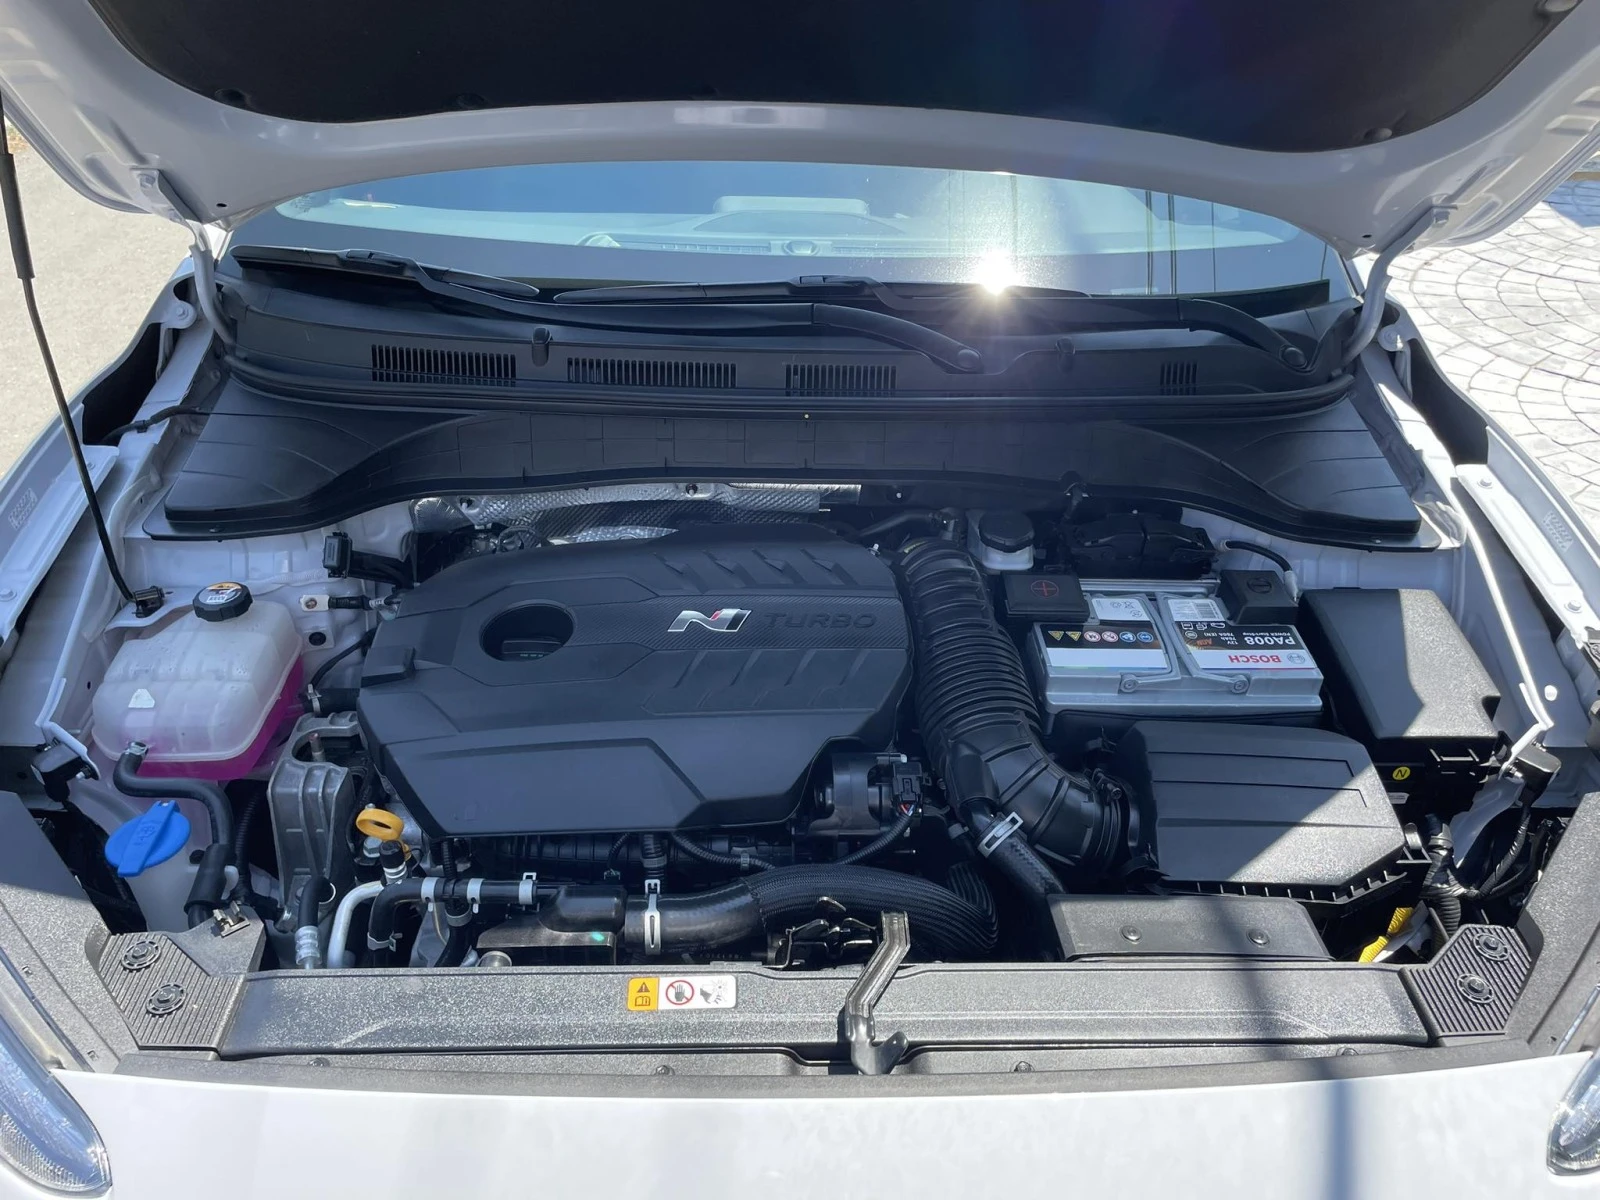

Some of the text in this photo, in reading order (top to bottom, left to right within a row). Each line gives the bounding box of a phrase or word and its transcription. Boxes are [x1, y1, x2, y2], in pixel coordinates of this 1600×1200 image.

[763, 612, 878, 629] TURBO
[1244, 636, 1296, 645] PA008
[1228, 655, 1282, 663] BOSCH
